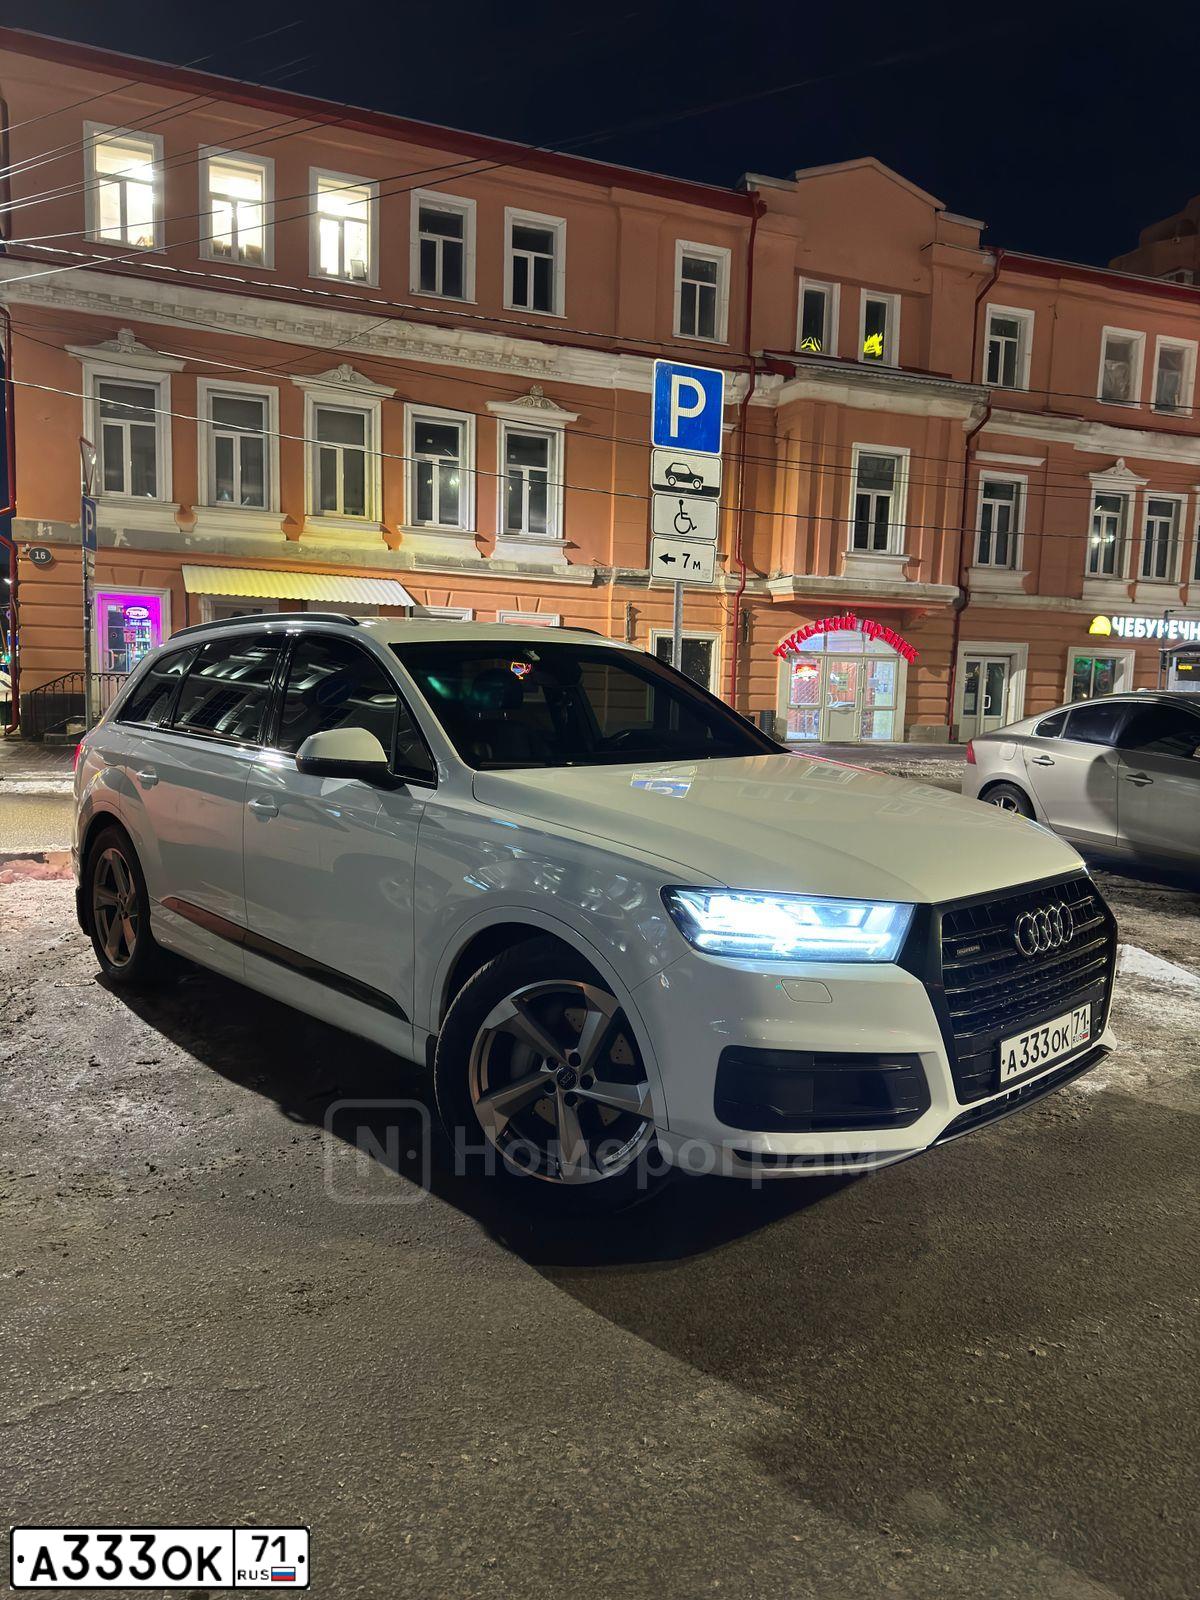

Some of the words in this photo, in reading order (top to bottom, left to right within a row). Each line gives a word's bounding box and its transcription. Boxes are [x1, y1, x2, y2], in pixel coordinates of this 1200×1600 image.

[670, 374, 707, 438] P
[85, 504, 94, 543] P
[34, 551, 46, 560] 16
[682, 553, 691, 570] 7
[1073, 1008, 1087, 1035] 71
